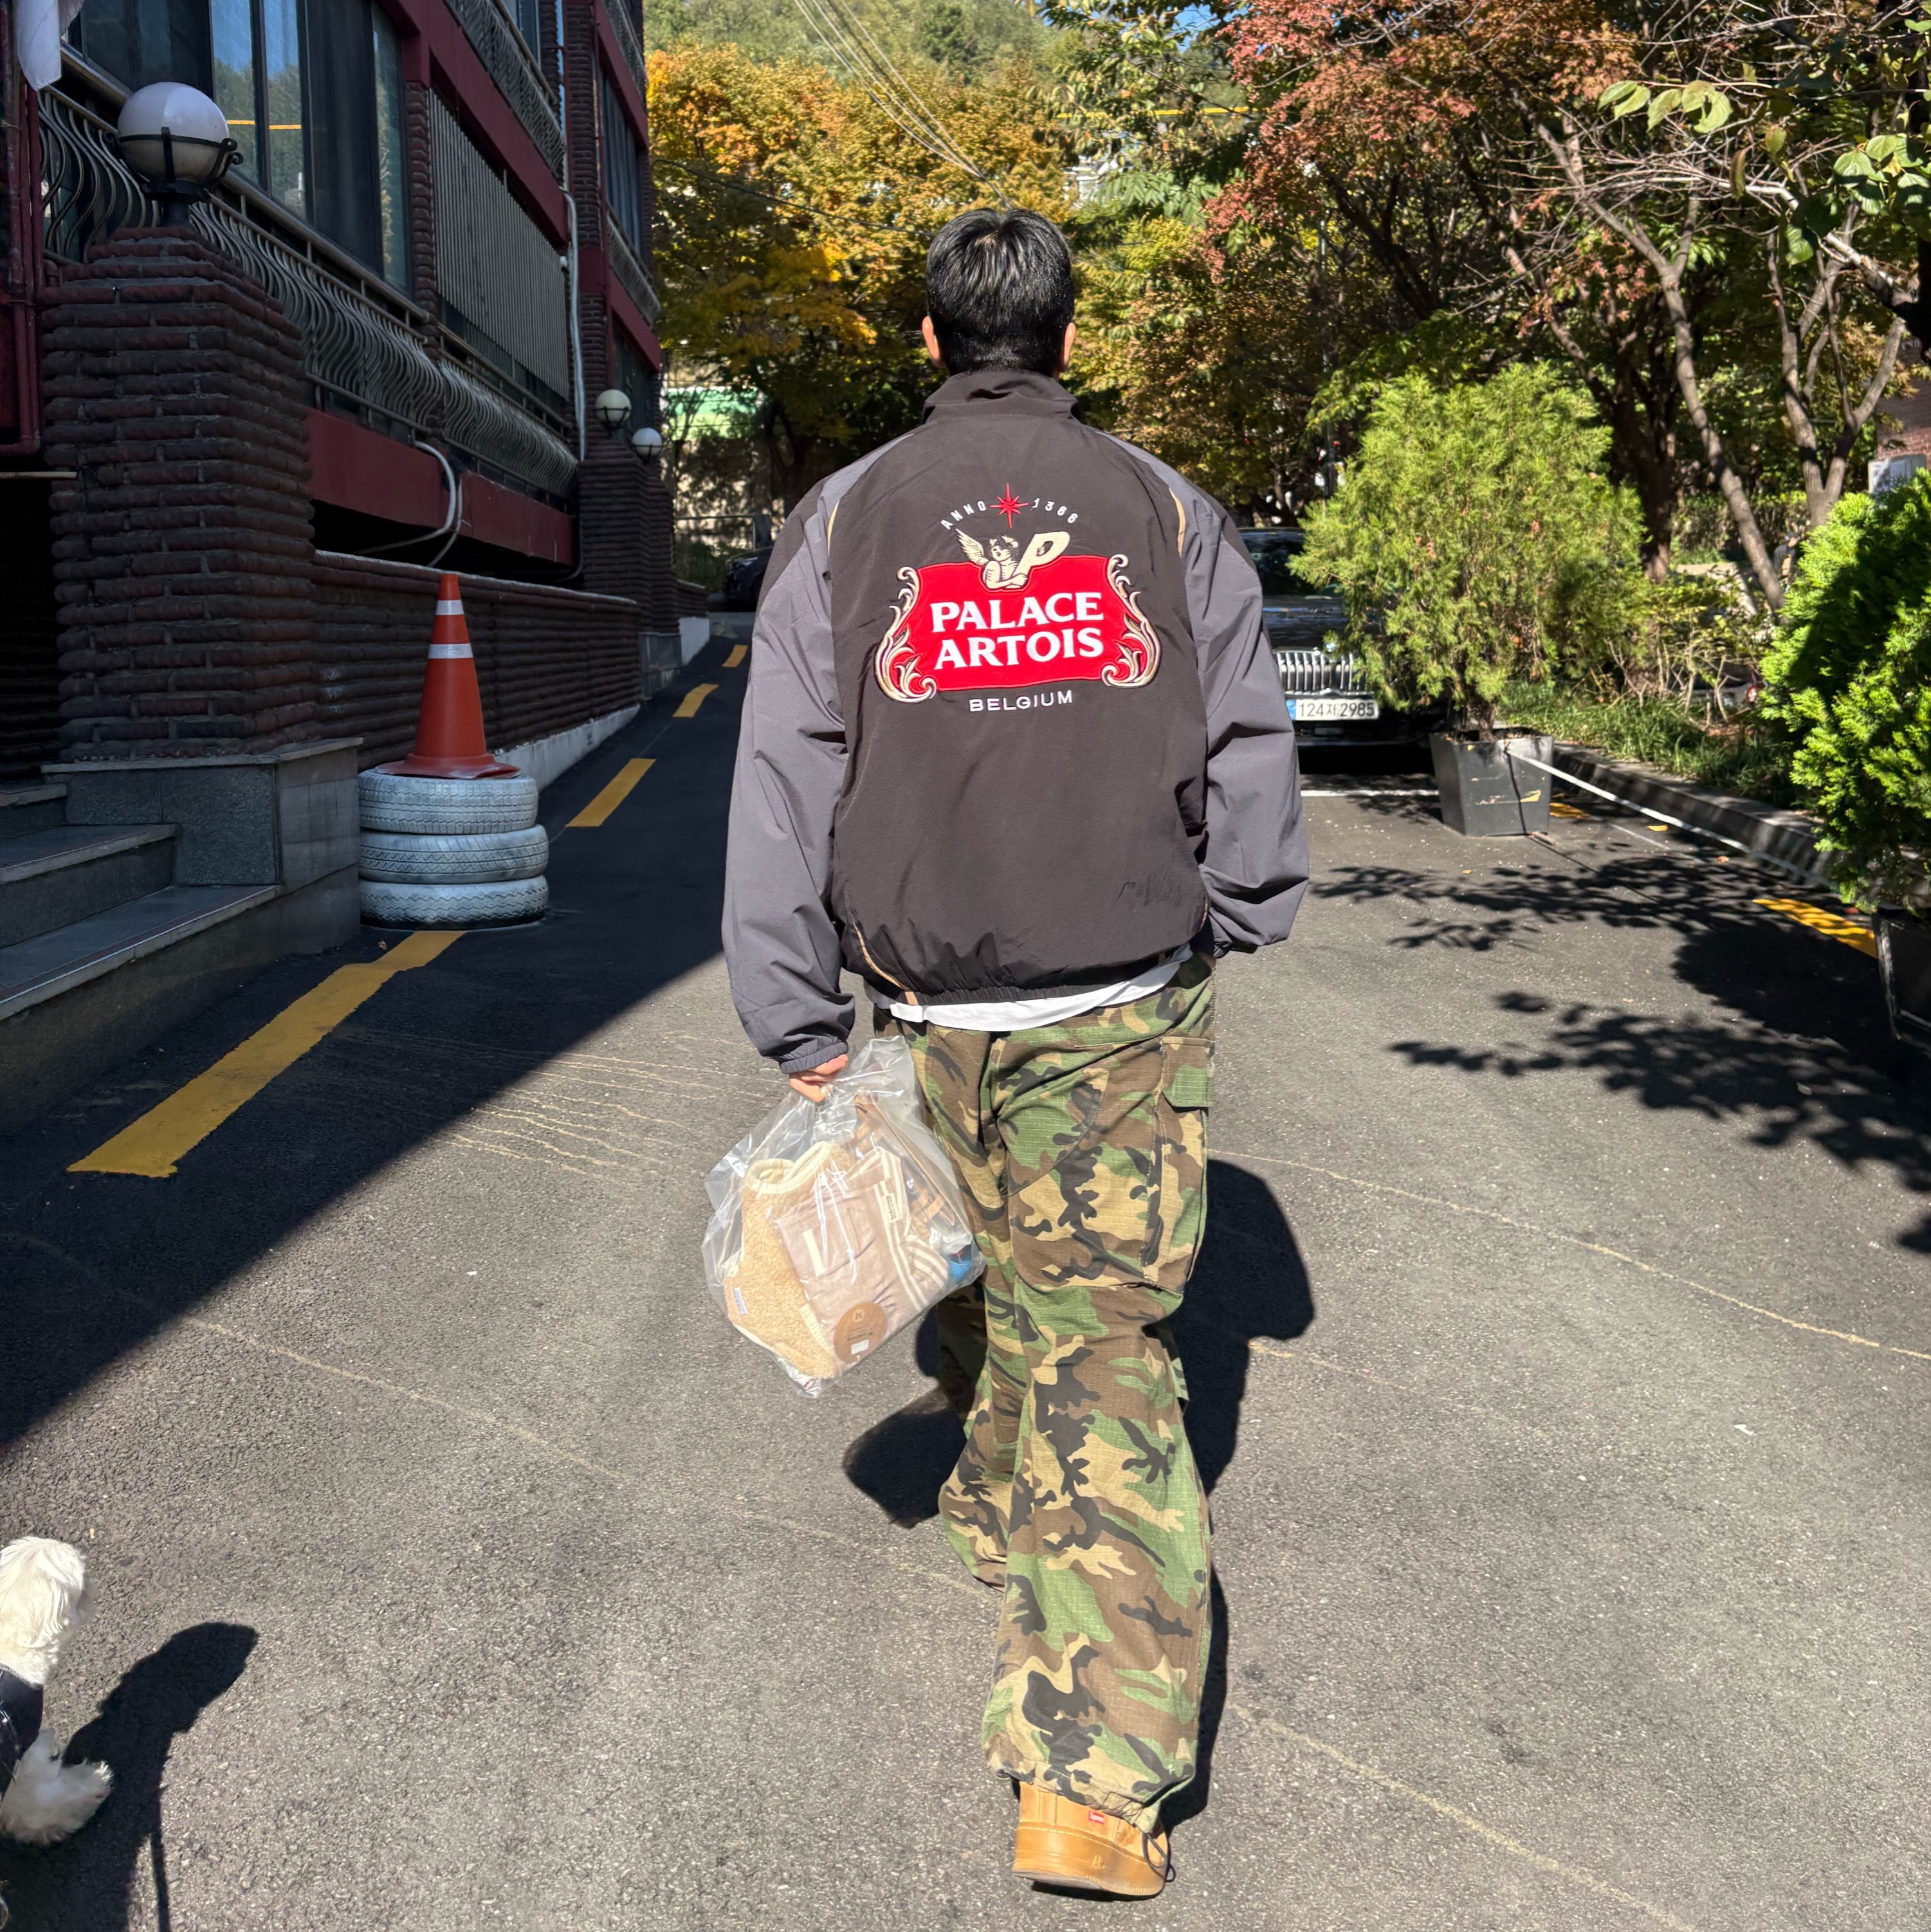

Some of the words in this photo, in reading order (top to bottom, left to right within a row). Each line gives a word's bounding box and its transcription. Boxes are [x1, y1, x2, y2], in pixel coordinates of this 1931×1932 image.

[940, 500, 987, 530] ANNO
[1030, 498, 1078, 524] 1366
[930, 592, 1104, 633] PALACE
[934, 627, 1104, 670] ARTOIS
[969, 689, 1073, 712] BELGIUM
